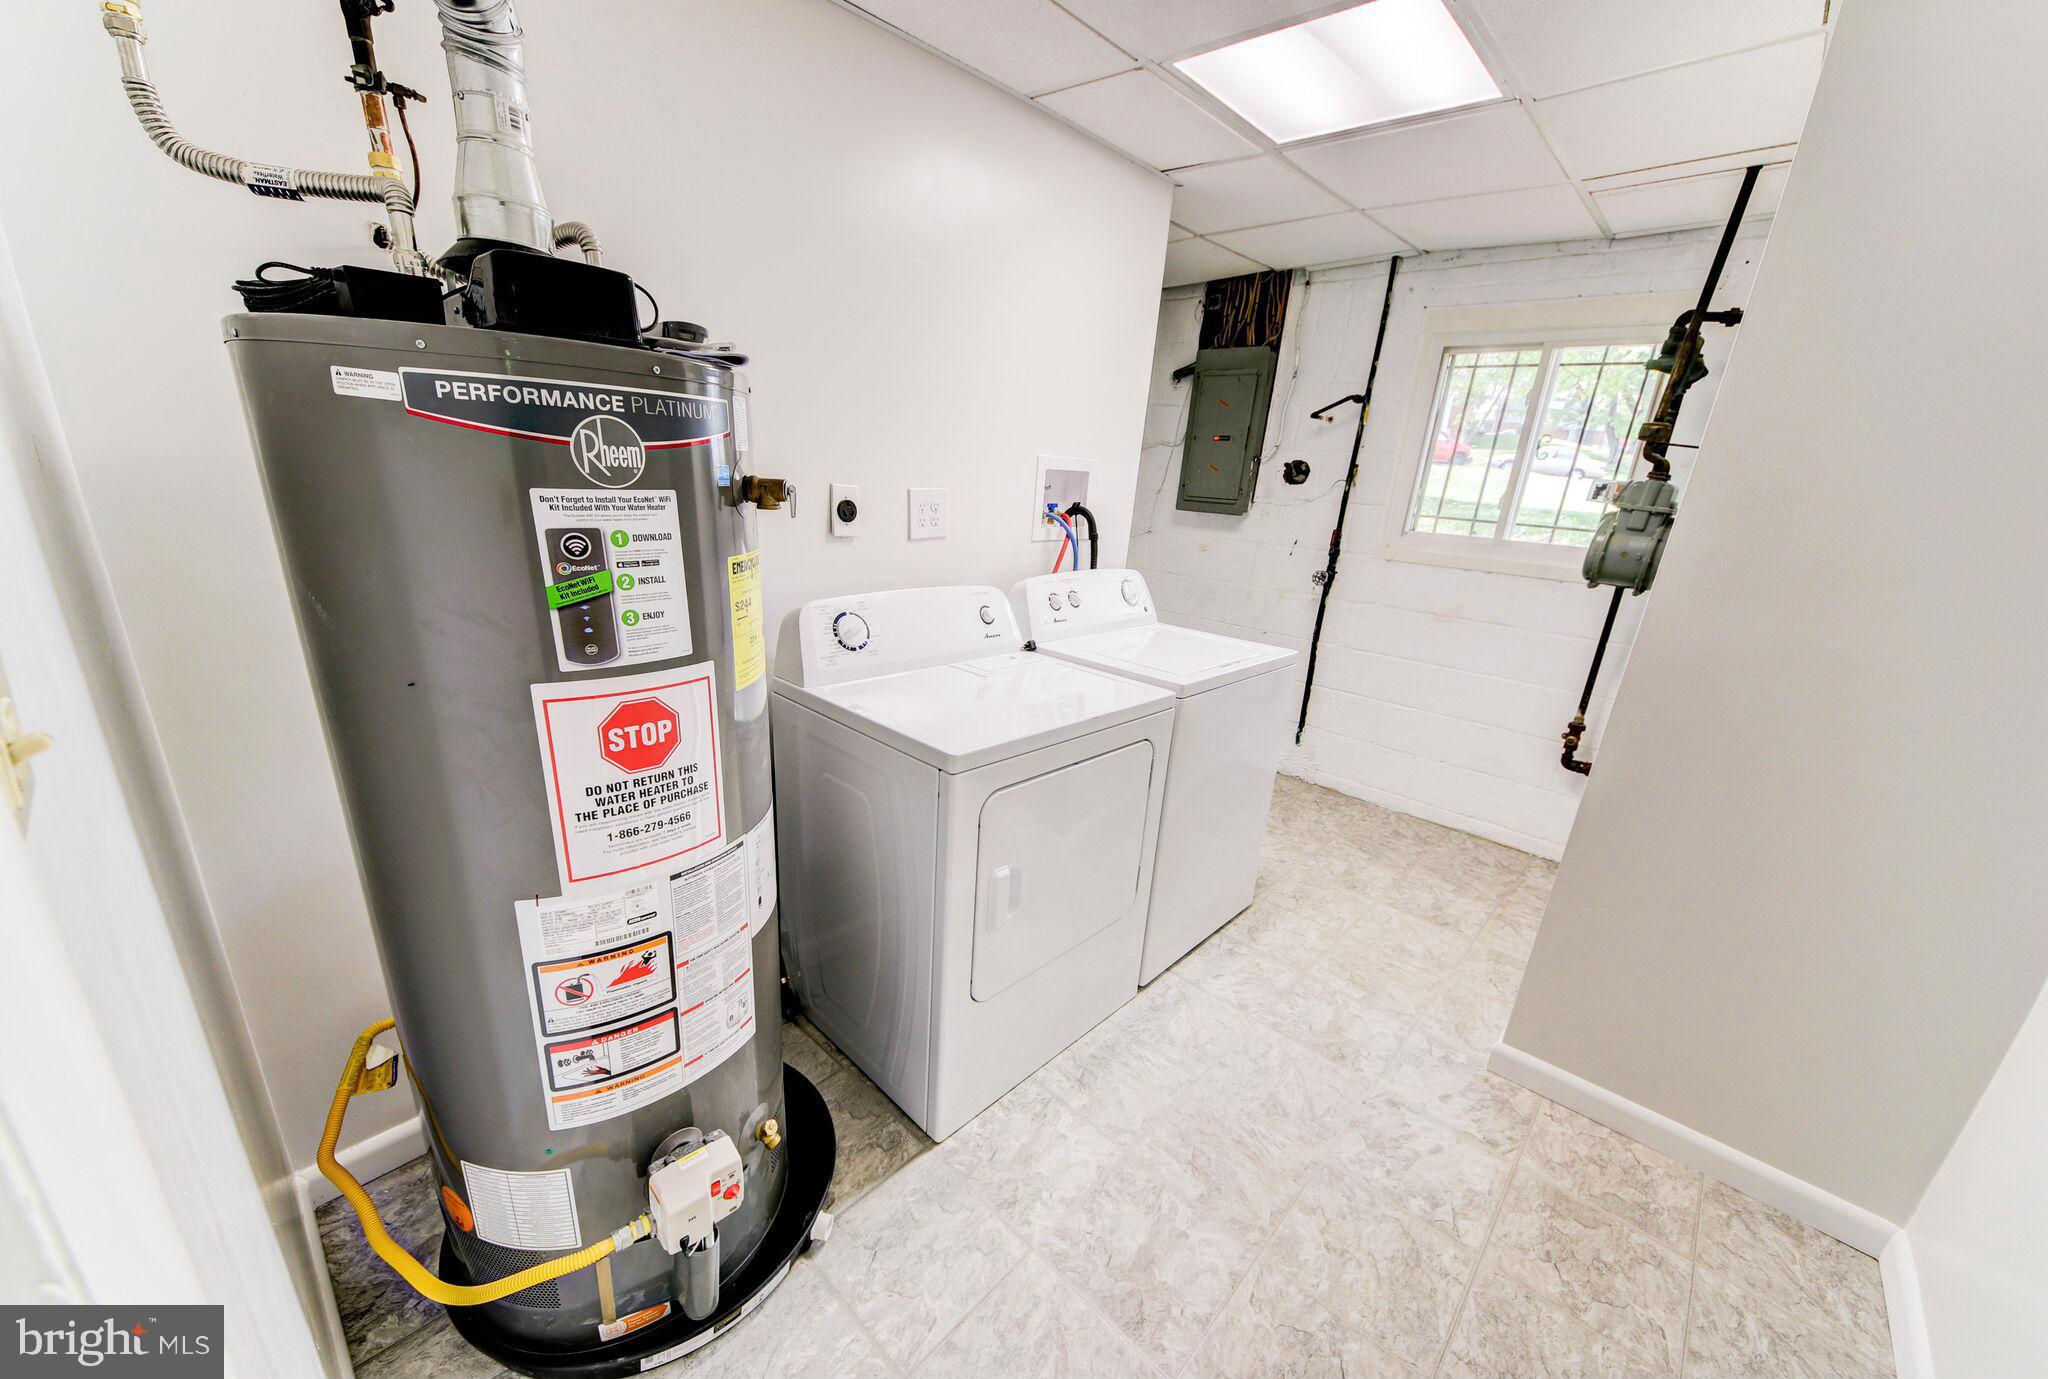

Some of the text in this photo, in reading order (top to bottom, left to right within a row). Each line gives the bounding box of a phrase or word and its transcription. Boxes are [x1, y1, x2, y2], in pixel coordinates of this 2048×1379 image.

[344, 371, 373, 379] WARNING
[435, 380, 713, 420] PERFORMANCE PLATINUM
[579, 418, 641, 477] Rheem
[539, 495, 559, 503] Don't
[561, 496, 585, 504] Forget
[615, 533, 672, 545] 1 DOWNLOAD
[556, 577, 596, 592] EcoNet WiFi
[621, 576, 666, 588] 2 INSTALL
[559, 592, 570, 600] Kit
[571, 585, 599, 598] Included
[627, 611, 665, 624] 3 ENJOY
[608, 720, 672, 752] STOP
[585, 763, 698, 796] DO NOT RETURN THIS
[595, 776, 694, 807] WATER HEATER TO
[575, 781, 709, 822] THE PLACE OF PURCHASE
[607, 811, 691, 841] 1-866-279-4566
[588, 949, 634, 965] WARNING
[602, 1027, 639, 1043] DANGER
[606, 1074, 645, 1091] WARNING
